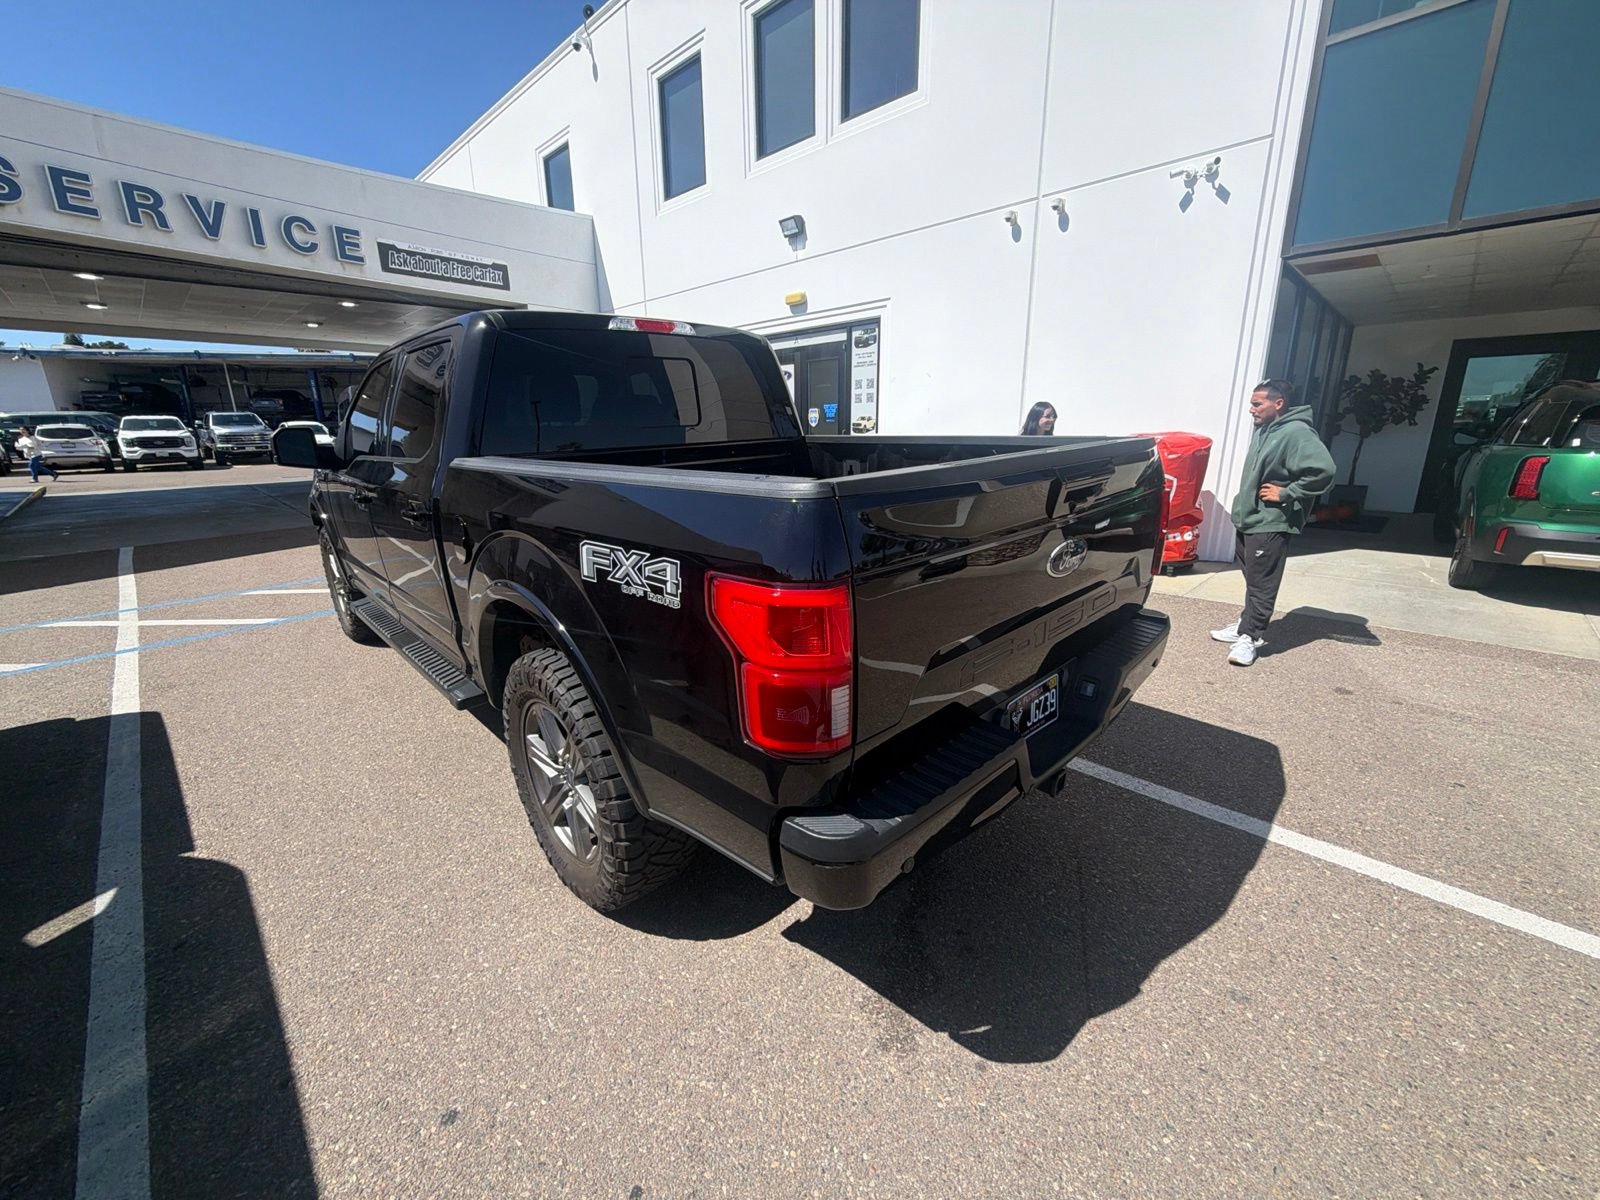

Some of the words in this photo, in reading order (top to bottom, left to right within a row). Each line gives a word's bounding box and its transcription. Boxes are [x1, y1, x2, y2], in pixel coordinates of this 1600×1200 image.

[388, 250, 412, 271] Ask
[410, 256, 442, 276] about
[442, 262, 451, 277] a
[451, 261, 473, 280] Free
[472, 264, 504, 285] Carfax
[580, 540, 682, 600] FX4
